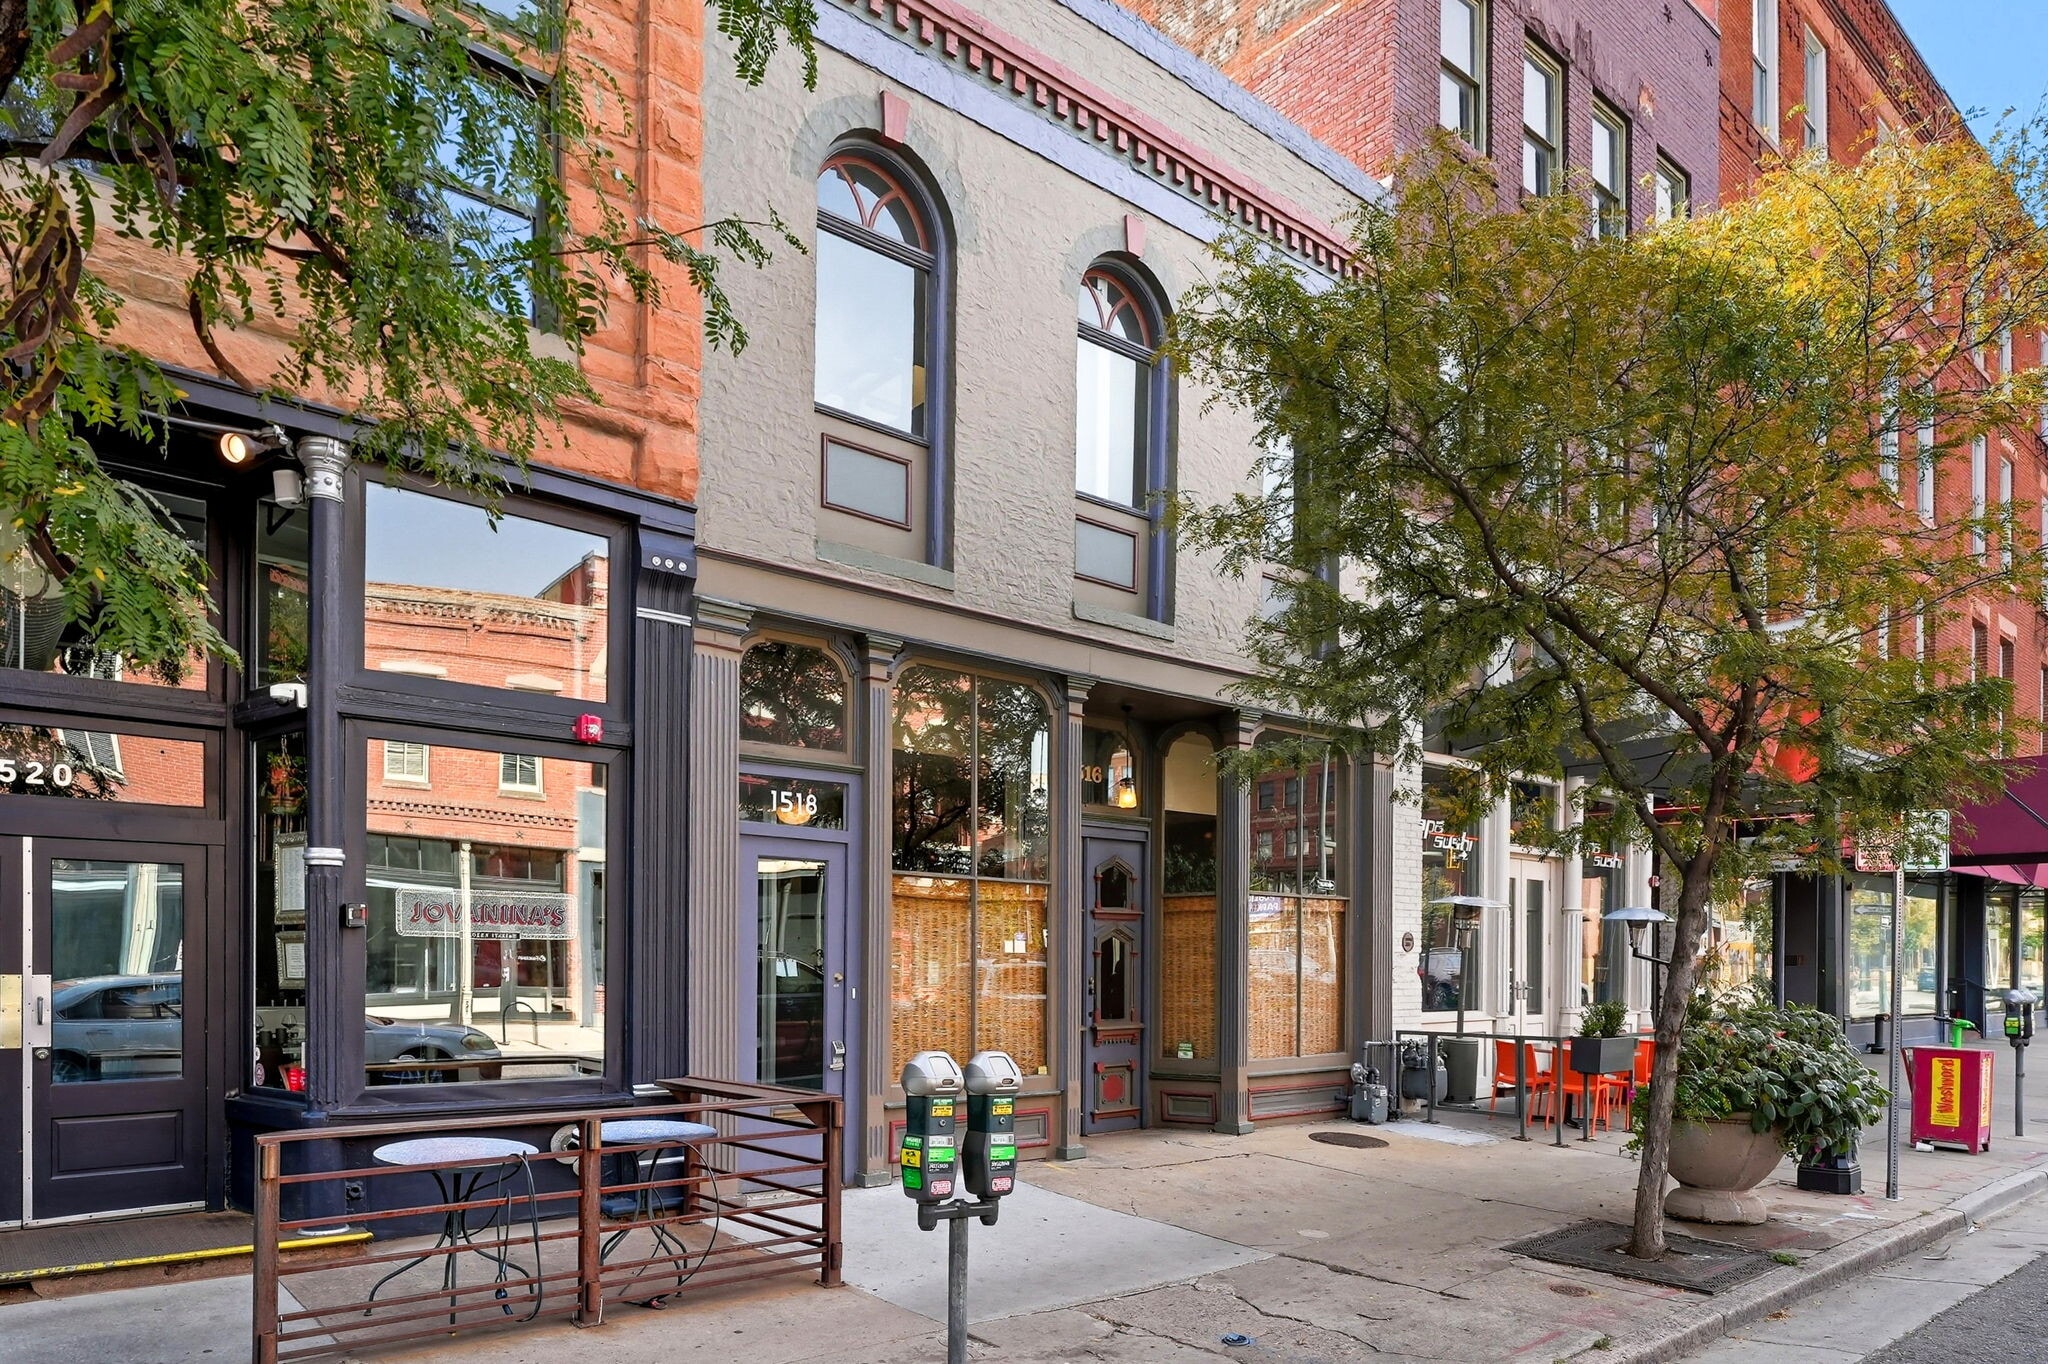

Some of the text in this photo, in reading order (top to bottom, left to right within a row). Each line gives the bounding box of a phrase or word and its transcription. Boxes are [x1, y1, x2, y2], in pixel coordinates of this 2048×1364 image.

[770, 789, 817, 816] 1518
[1433, 832, 1473, 852] sushi
[1592, 851, 1623, 869] sushi
[410, 901, 566, 927] JOVANINA'S
[1936, 1058, 1954, 1114] Westword
